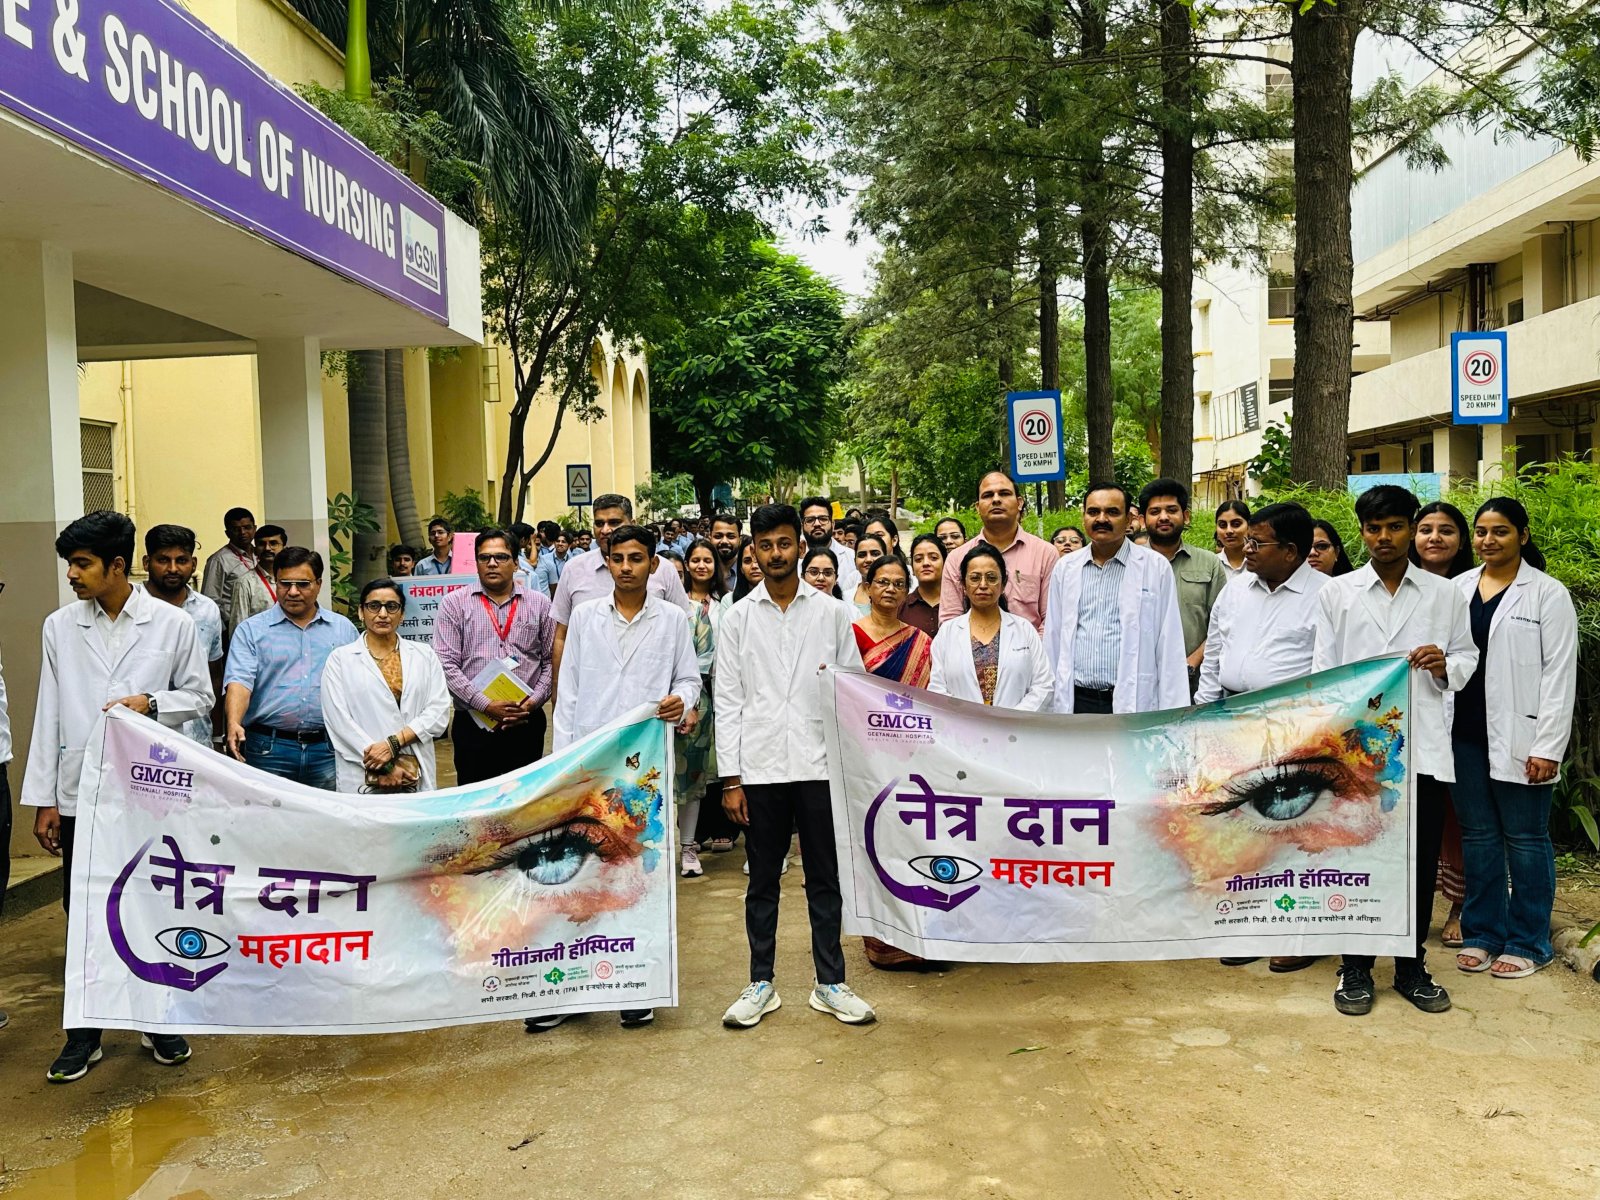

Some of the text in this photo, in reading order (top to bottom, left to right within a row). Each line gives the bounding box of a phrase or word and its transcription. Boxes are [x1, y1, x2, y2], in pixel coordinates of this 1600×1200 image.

[53, 0, 90, 83] &
[103, 14, 251, 178] SCHOOL
[259, 120, 293, 200] OF
[302, 147, 396, 260] NURSING
[414, 241, 438, 278] GSN
[1471, 359, 1491, 376] 20
[1026, 419, 1046, 435] 20
[409, 584, 443, 597] नेत्रदान
[867, 713, 933, 730] GMCH
[130, 764, 194, 788] GMCH
[130, 784, 160, 795] GEETANJALI
[163, 790, 191, 799] HOSPITAL
[896, 773, 1115, 847] नेत्र दान
[149, 835, 377, 918] नेत्र दान
[990, 857, 1115, 889] महादान
[1225, 868, 1371, 892] गीतांजली हॉस्पिटल
[237, 930, 374, 969] महादान
[491, 934, 636, 968] गीतांजली हॉस्पिटल
